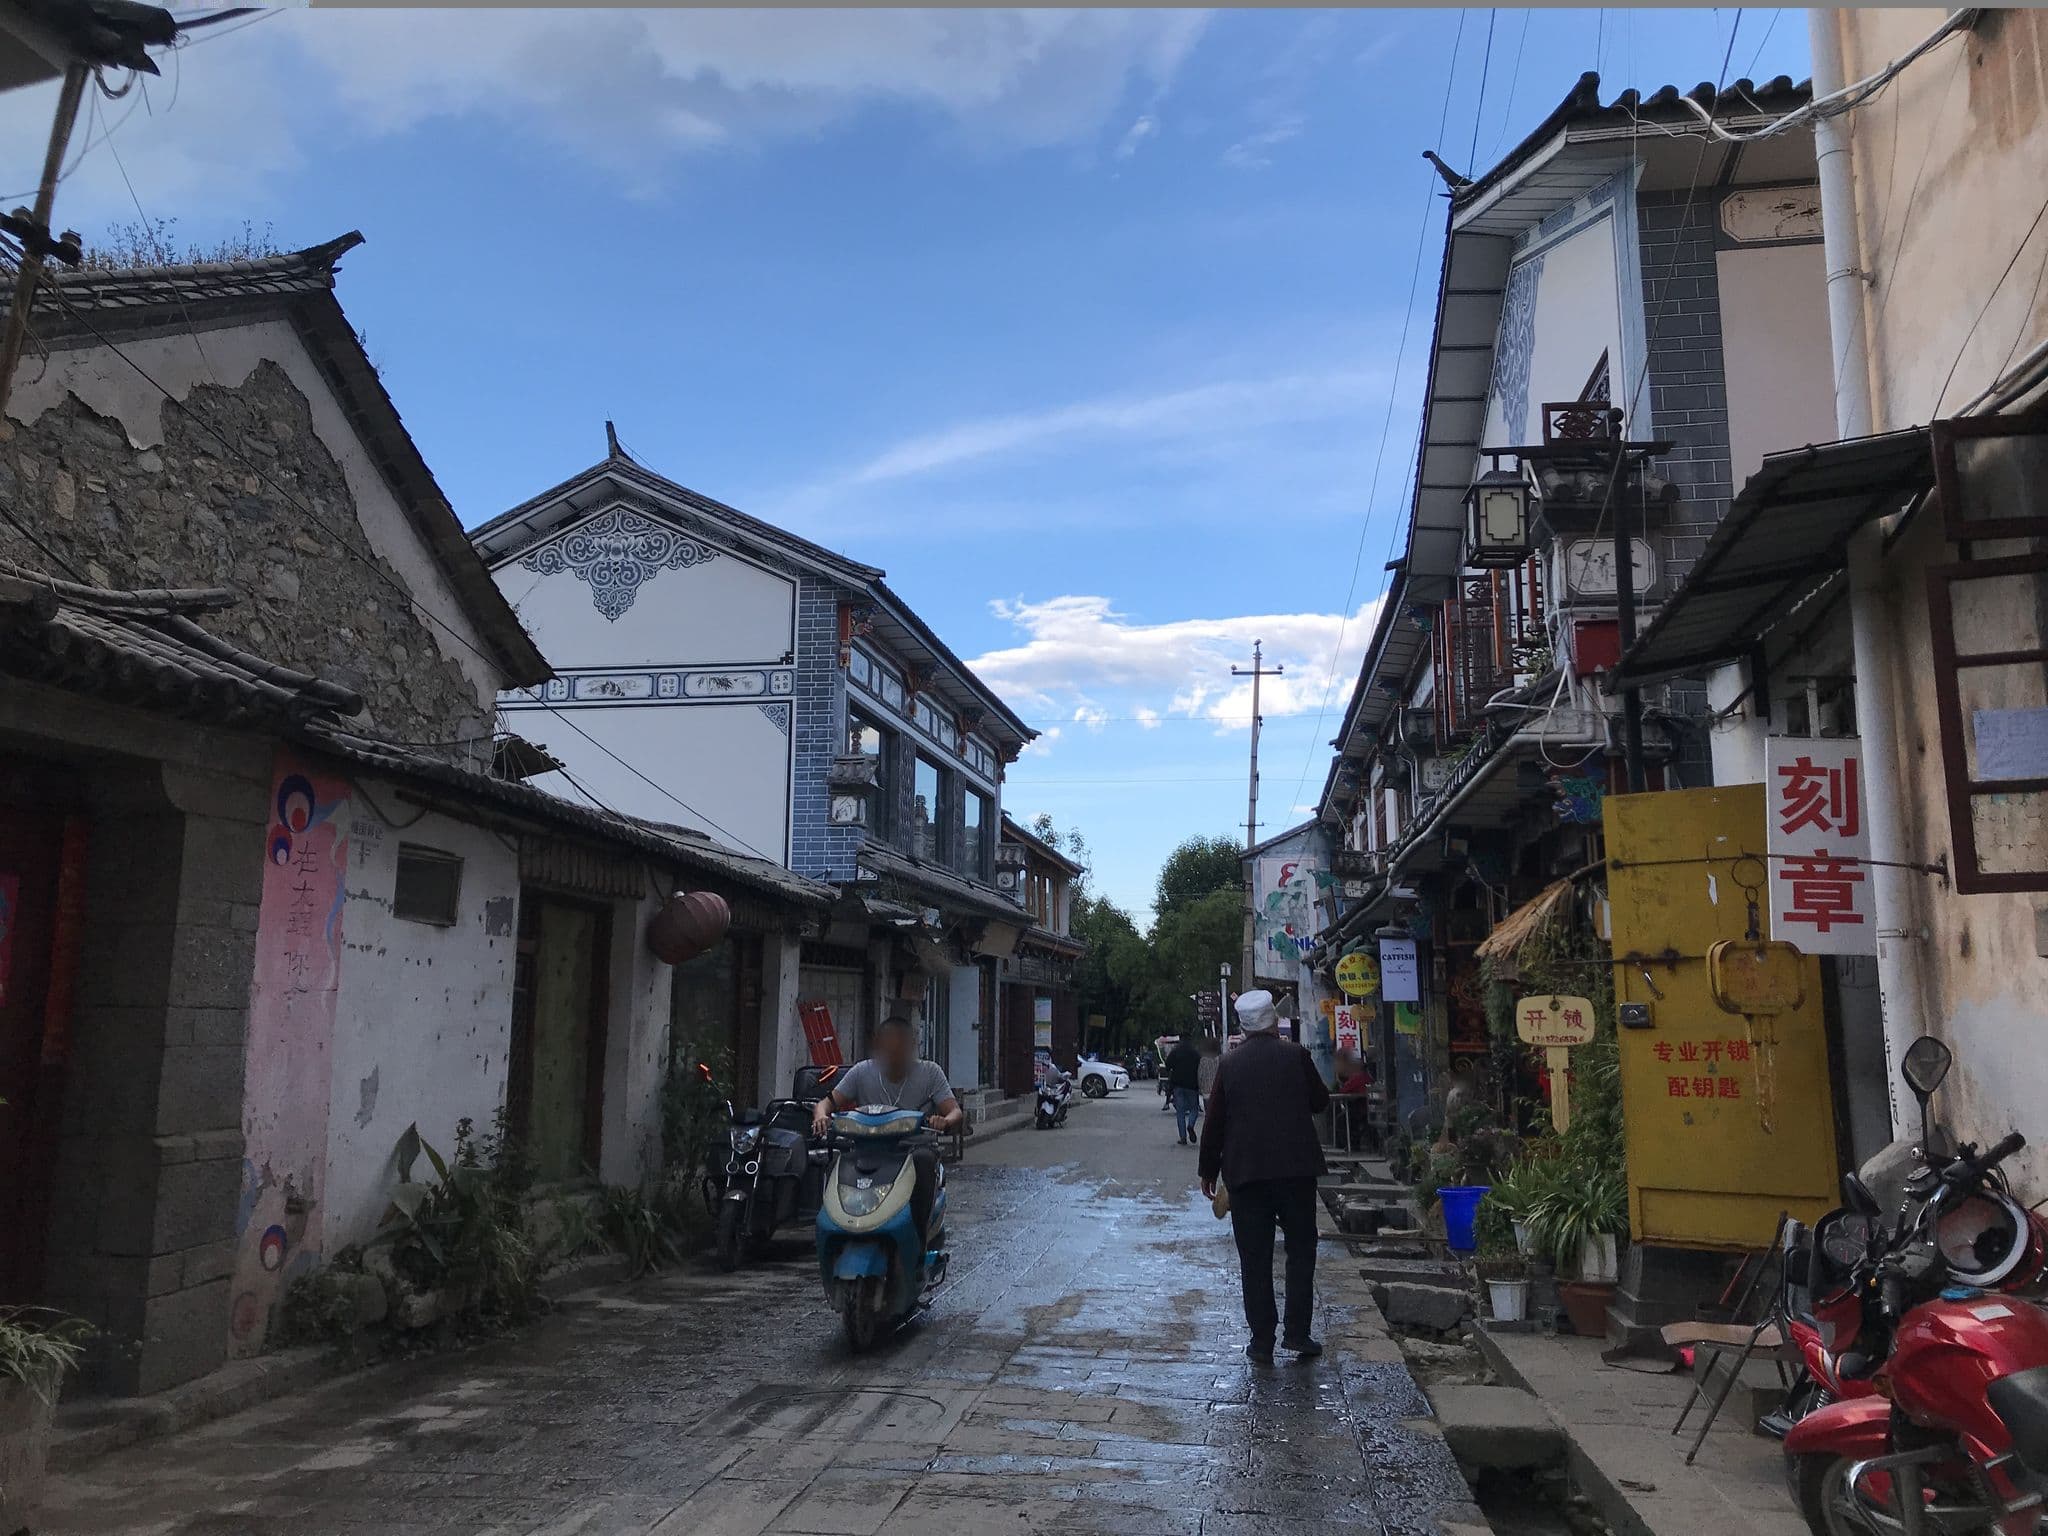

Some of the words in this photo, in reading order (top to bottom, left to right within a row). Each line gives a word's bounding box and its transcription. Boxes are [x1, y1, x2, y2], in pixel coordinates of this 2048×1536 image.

[1778, 757, 1864, 932] 刻章
[1382, 953, 1415, 961] CATFISH
[1523, 1009, 1587, 1031] 开锁
[1652, 1039, 1750, 1062] 专业开锁
[1667, 1076, 1742, 1098] 配钥匙
